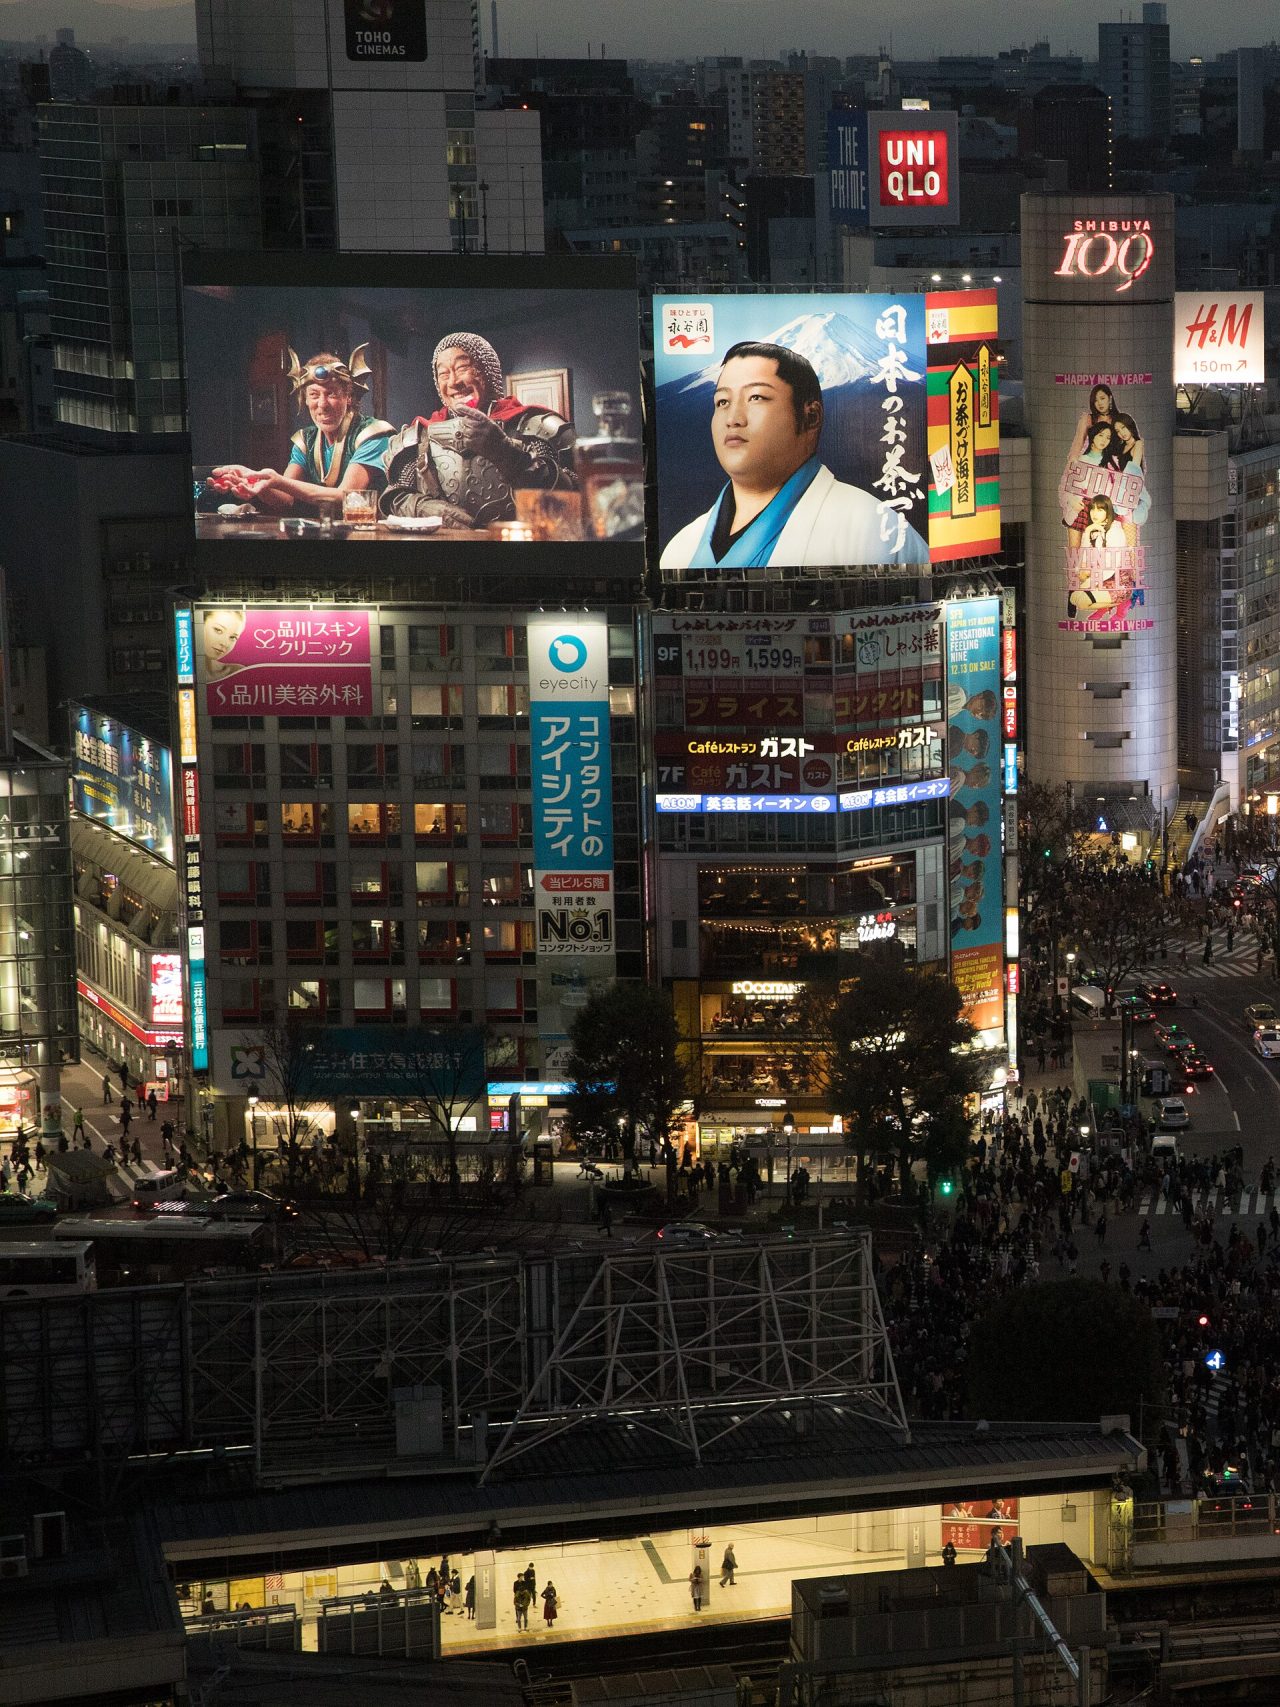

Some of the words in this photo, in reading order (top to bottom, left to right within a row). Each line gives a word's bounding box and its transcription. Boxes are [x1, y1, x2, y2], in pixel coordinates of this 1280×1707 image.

[356, 32, 391, 43] TOHO
[356, 45, 406, 55] CINEMAS
[838, 126, 858, 166] THE
[886, 140, 935, 166] UNI
[831, 170, 866, 209] PRIME
[887, 171, 941, 201] QLO
[1074, 220, 1150, 231] SHIBUYA
[1054, 233, 1154, 292] 109
[1186, 303, 1253, 349] H&M
[1193, 360, 1232, 372] 150m
[1064, 374, 1095, 384] HAPPY
[1098, 374, 1118, 384] NEW
[1121, 373, 1144, 384] YEAR
[870, 304, 925, 555] 日本のお茶づけ
[955, 381, 970, 503] お茶づけ海苔
[1064, 461, 1144, 509] 2018
[277, 621, 361, 638] 品川スキン
[672, 618, 797, 632] しゃぶしゃぶバイキング
[850, 608, 942, 630] しゃぶしゃぶバイキング
[1127, 620, 1147, 631] WED
[886, 629, 939, 657] しゃぶ葉
[951, 627, 995, 641] SENSATIONAL
[178, 619, 190, 672] 東急リバブル
[278, 641, 353, 656] クリニック
[657, 647, 679, 661] 9F
[951, 641, 979, 652] FEELING
[686, 649, 740, 669] 1,199円
[745, 648, 801, 669] 1,599円
[951, 653, 967, 663] NINE
[979, 660, 995, 671] SALE
[231, 684, 364, 705] 品川美容外科
[539, 677, 598, 697] eyecity
[687, 696, 799, 719] プライス
[835, 688, 920, 717] コンタクト
[760, 737, 814, 758] ガスト
[898, 726, 938, 749] ガスト
[658, 766, 685, 782] 7F
[726, 763, 793, 789] ガスト
[540, 717, 574, 857] アイシティ
[579, 717, 604, 857] コンタクトの
[842, 793, 870, 808] AEON
[874, 783, 948, 806] 英会話イーオン
[660, 797, 697, 810] AEON
[706, 796, 806, 810] 英会話イーオン
[187, 852, 201, 908] 加藤眼科
[550, 877, 605, 889] 当ビル5階
[552, 896, 597, 906] 利用者数
[539, 908, 613, 943] No.1
[539, 944, 612, 953] コンタクトショップ
